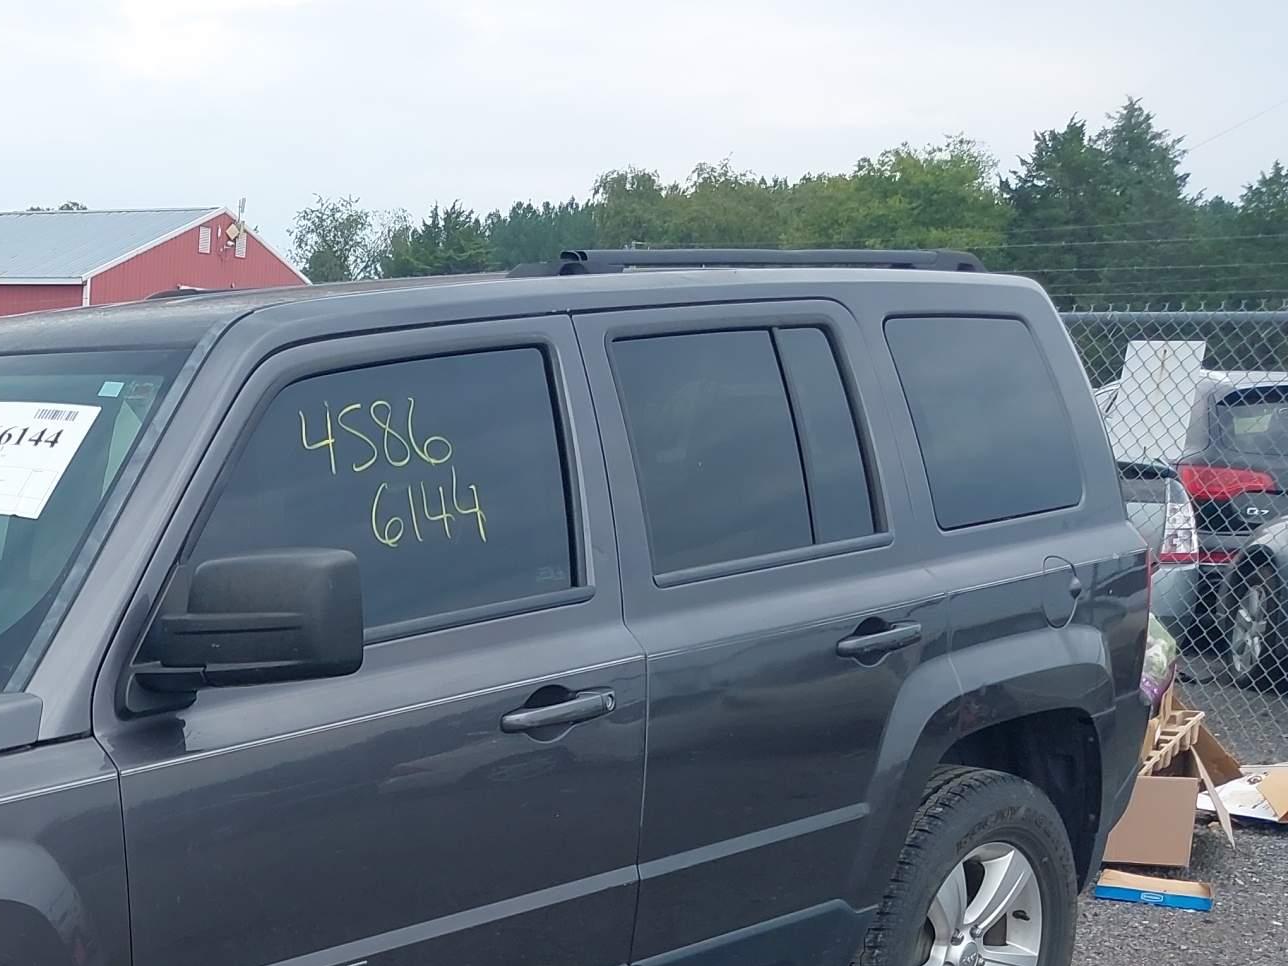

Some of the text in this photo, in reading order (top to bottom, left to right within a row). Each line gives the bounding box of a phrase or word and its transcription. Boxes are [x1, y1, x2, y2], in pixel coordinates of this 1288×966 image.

[298, 397, 452, 475] 4586
[372, 465, 486, 547] 6144
[1246, 507, 1270, 516] Q7
